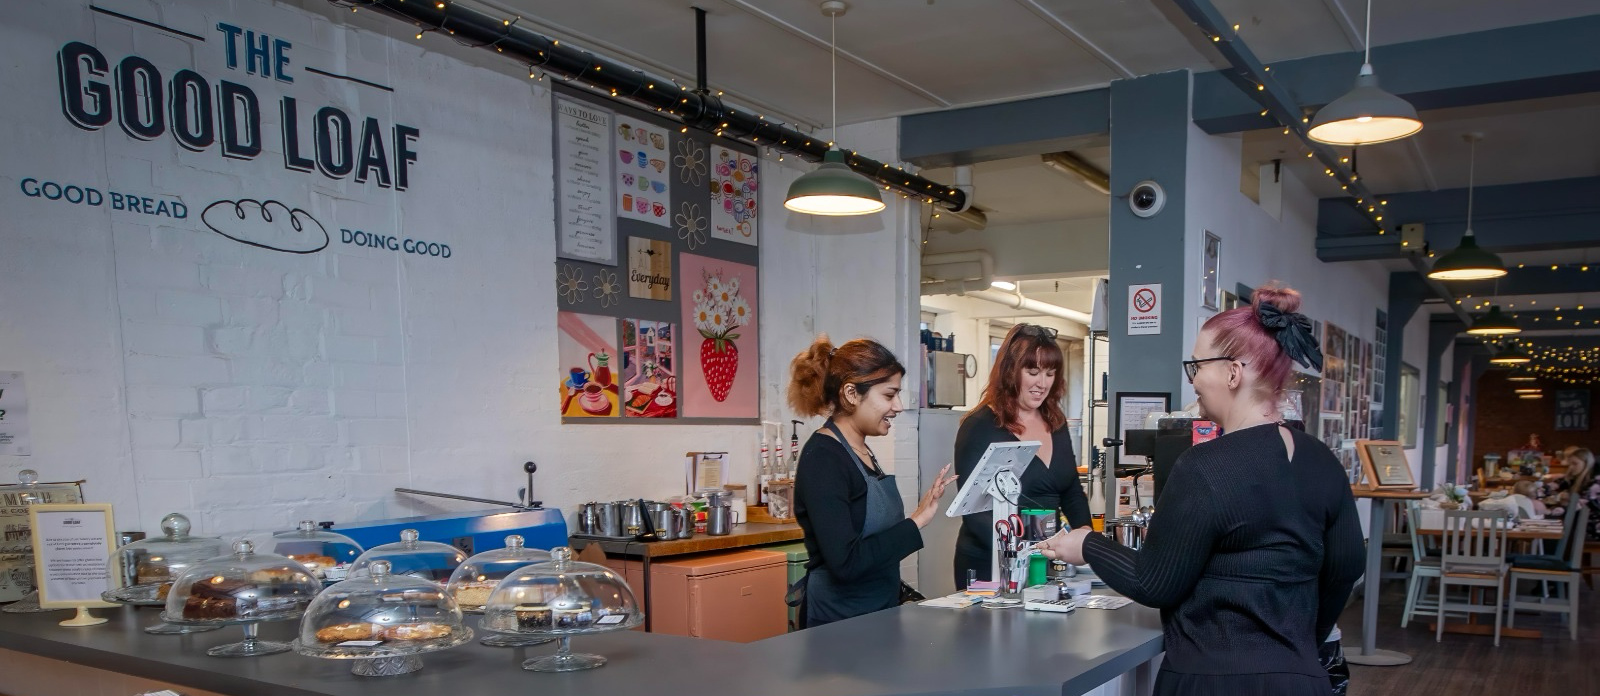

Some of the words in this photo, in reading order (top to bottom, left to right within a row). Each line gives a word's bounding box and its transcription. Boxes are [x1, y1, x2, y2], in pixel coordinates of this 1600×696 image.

[216, 21, 294, 84] THE
[56, 40, 262, 161] GOOD
[280, 96, 421, 192] LOAF
[578, 110, 588, 118] TO
[20, 178, 103, 207] GOOD
[108, 191, 188, 220] BREAD
[340, 228, 399, 252] DOING
[403, 239, 452, 259] GOOD
[631, 269, 670, 291] Everyday
